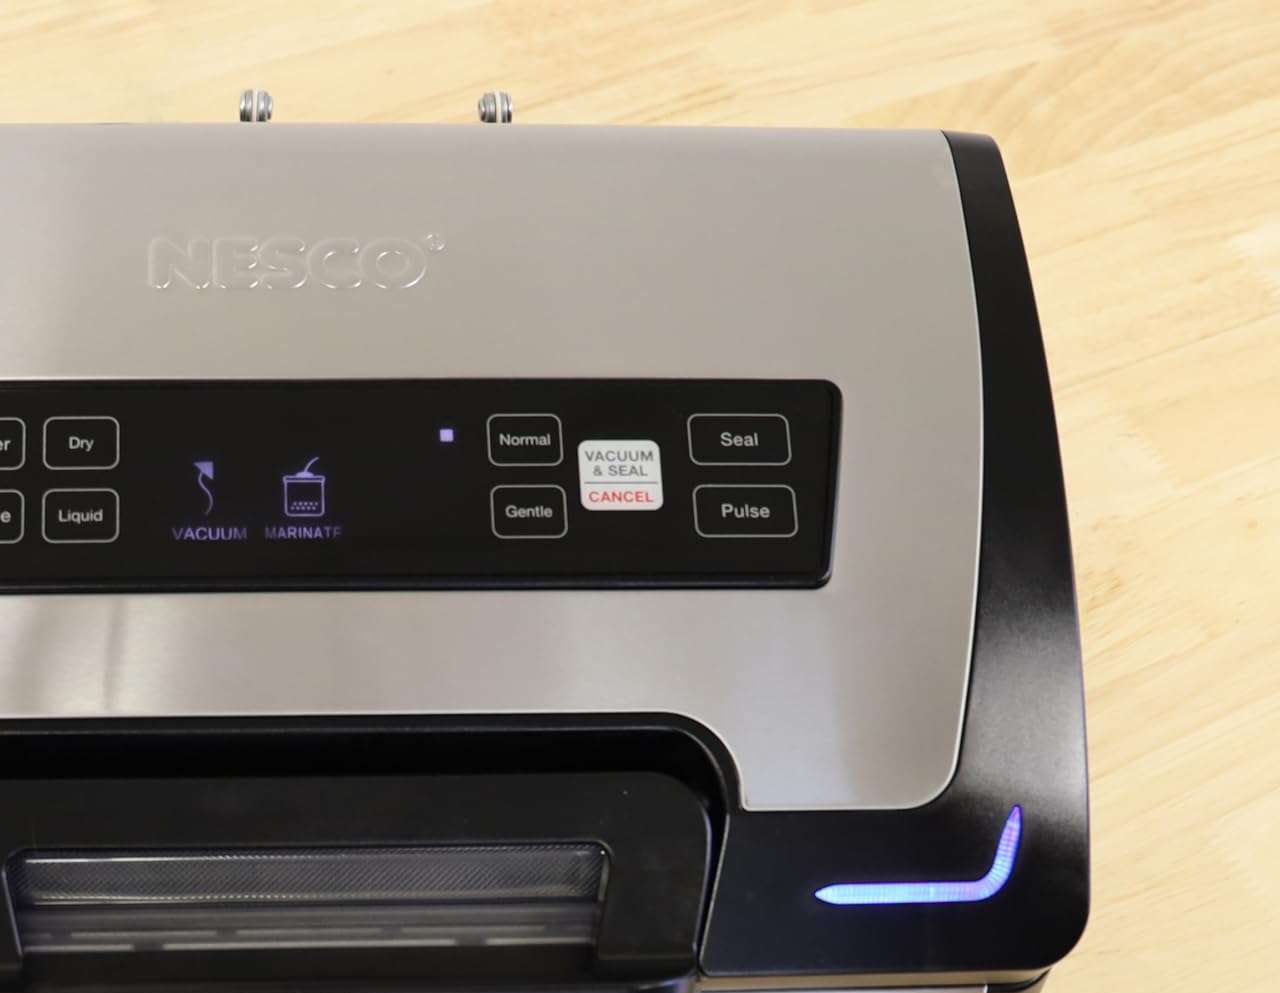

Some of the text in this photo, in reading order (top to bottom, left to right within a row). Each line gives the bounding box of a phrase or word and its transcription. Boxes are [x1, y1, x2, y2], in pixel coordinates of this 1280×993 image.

[68, 435, 94, 452] Dry
[499, 432, 551, 447] Normal
[720, 431, 759, 448] Seal
[584, 449, 654, 463] VACUUM
[592, 465, 648, 478] & SEAL
[588, 490, 654, 504] CANCEL
[58, 508, 104, 525] Liquid
[505, 504, 553, 519] Gentle
[721, 503, 770, 519] Pulse
[171, 525, 248, 541] VACUUM
